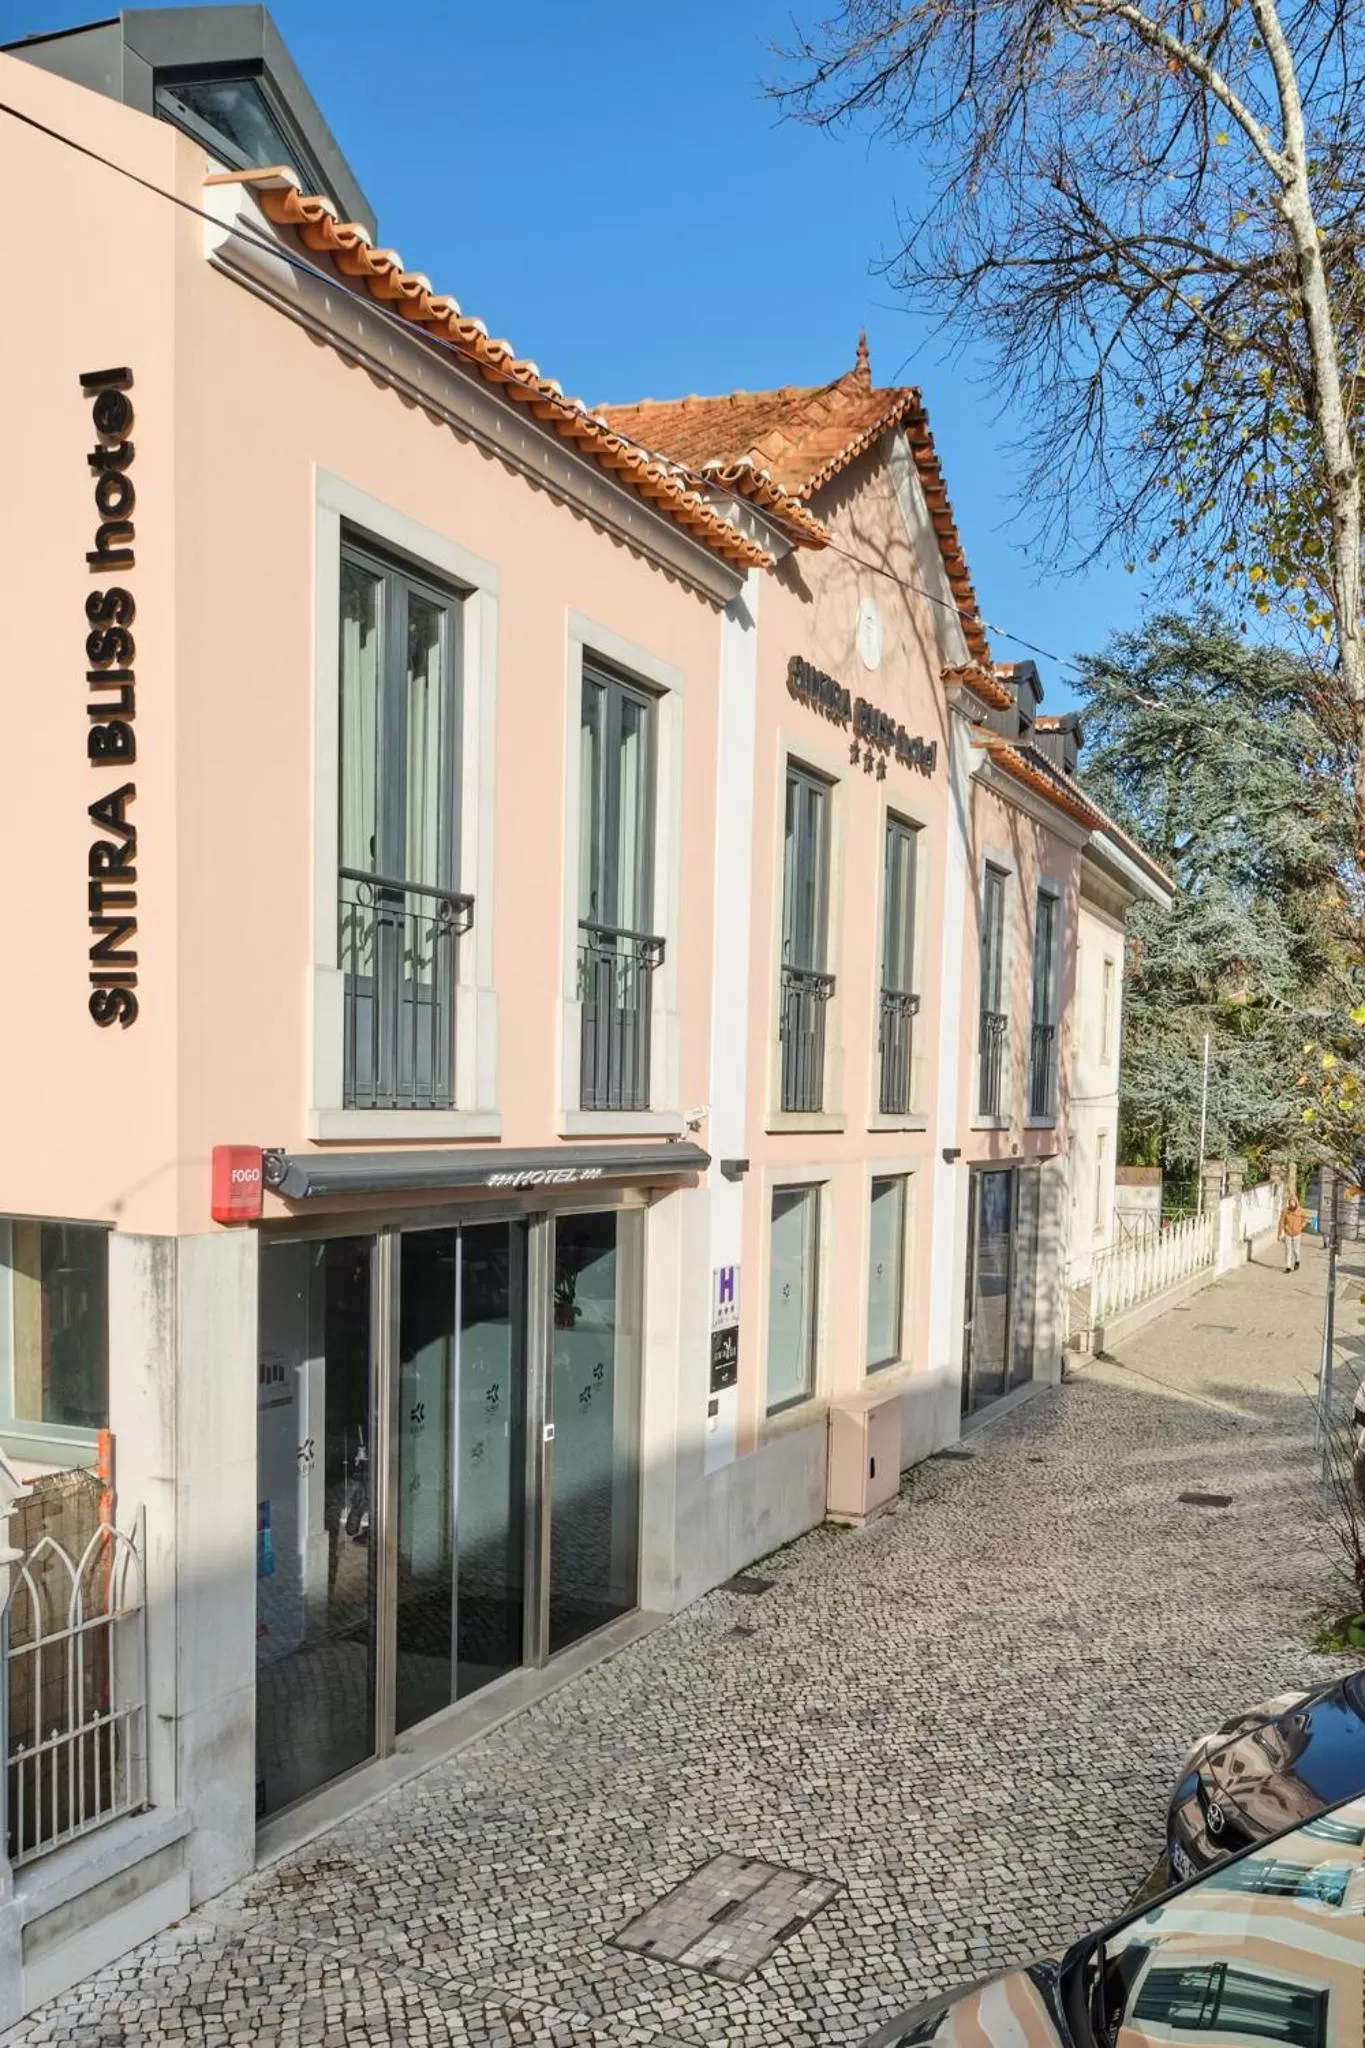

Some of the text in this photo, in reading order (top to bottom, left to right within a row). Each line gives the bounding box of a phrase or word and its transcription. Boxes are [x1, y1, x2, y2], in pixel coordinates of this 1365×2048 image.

[79, 366, 138, 1029] SINTRA BLISS hotel
[231, 1168, 260, 1183] FOGO
[512, 1168, 577, 1186] HOTEL
[719, 1265, 734, 1304] H
